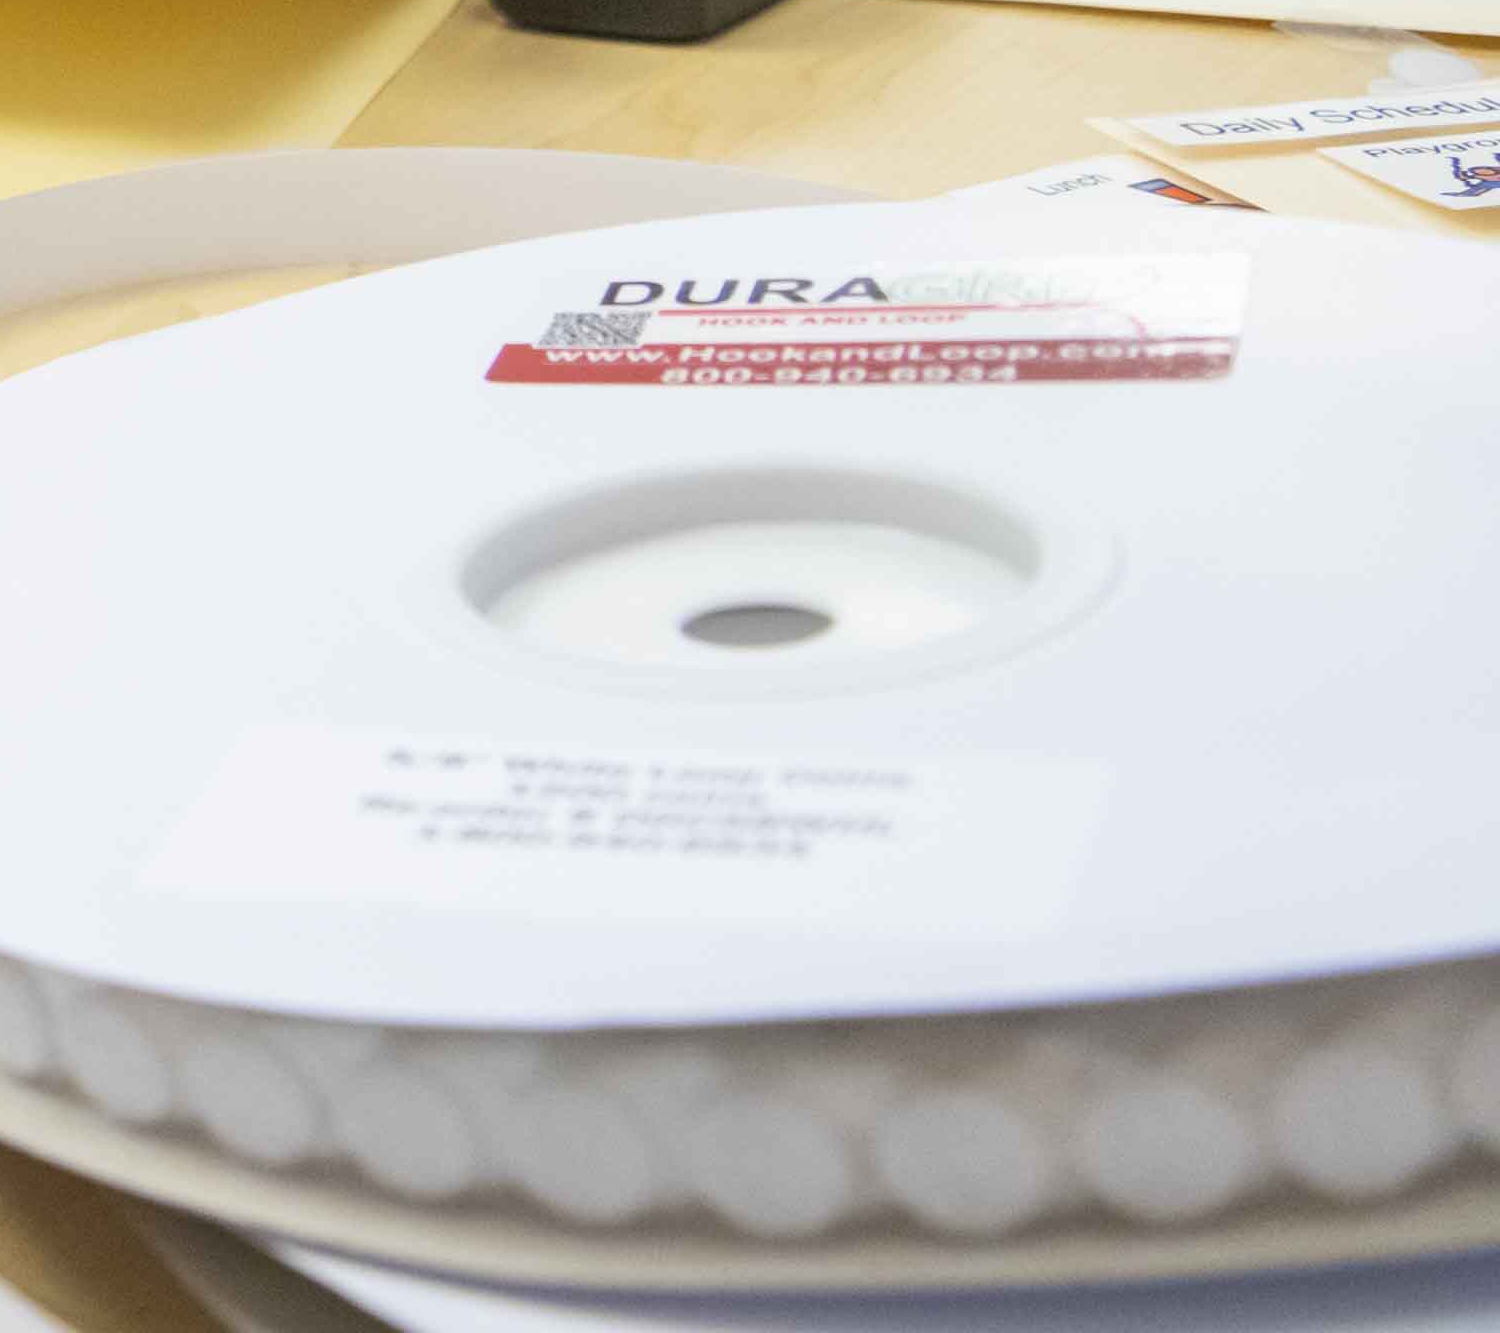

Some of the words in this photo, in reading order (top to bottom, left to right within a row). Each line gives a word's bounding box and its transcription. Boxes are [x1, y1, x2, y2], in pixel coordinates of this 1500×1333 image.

[1181, 116, 1306, 141] Daily
[1026, 172, 1115, 197] Lunch
[698, 315, 790, 327] HOOK
[801, 314, 869, 326] AND
[878, 313, 967, 325] LOOP
